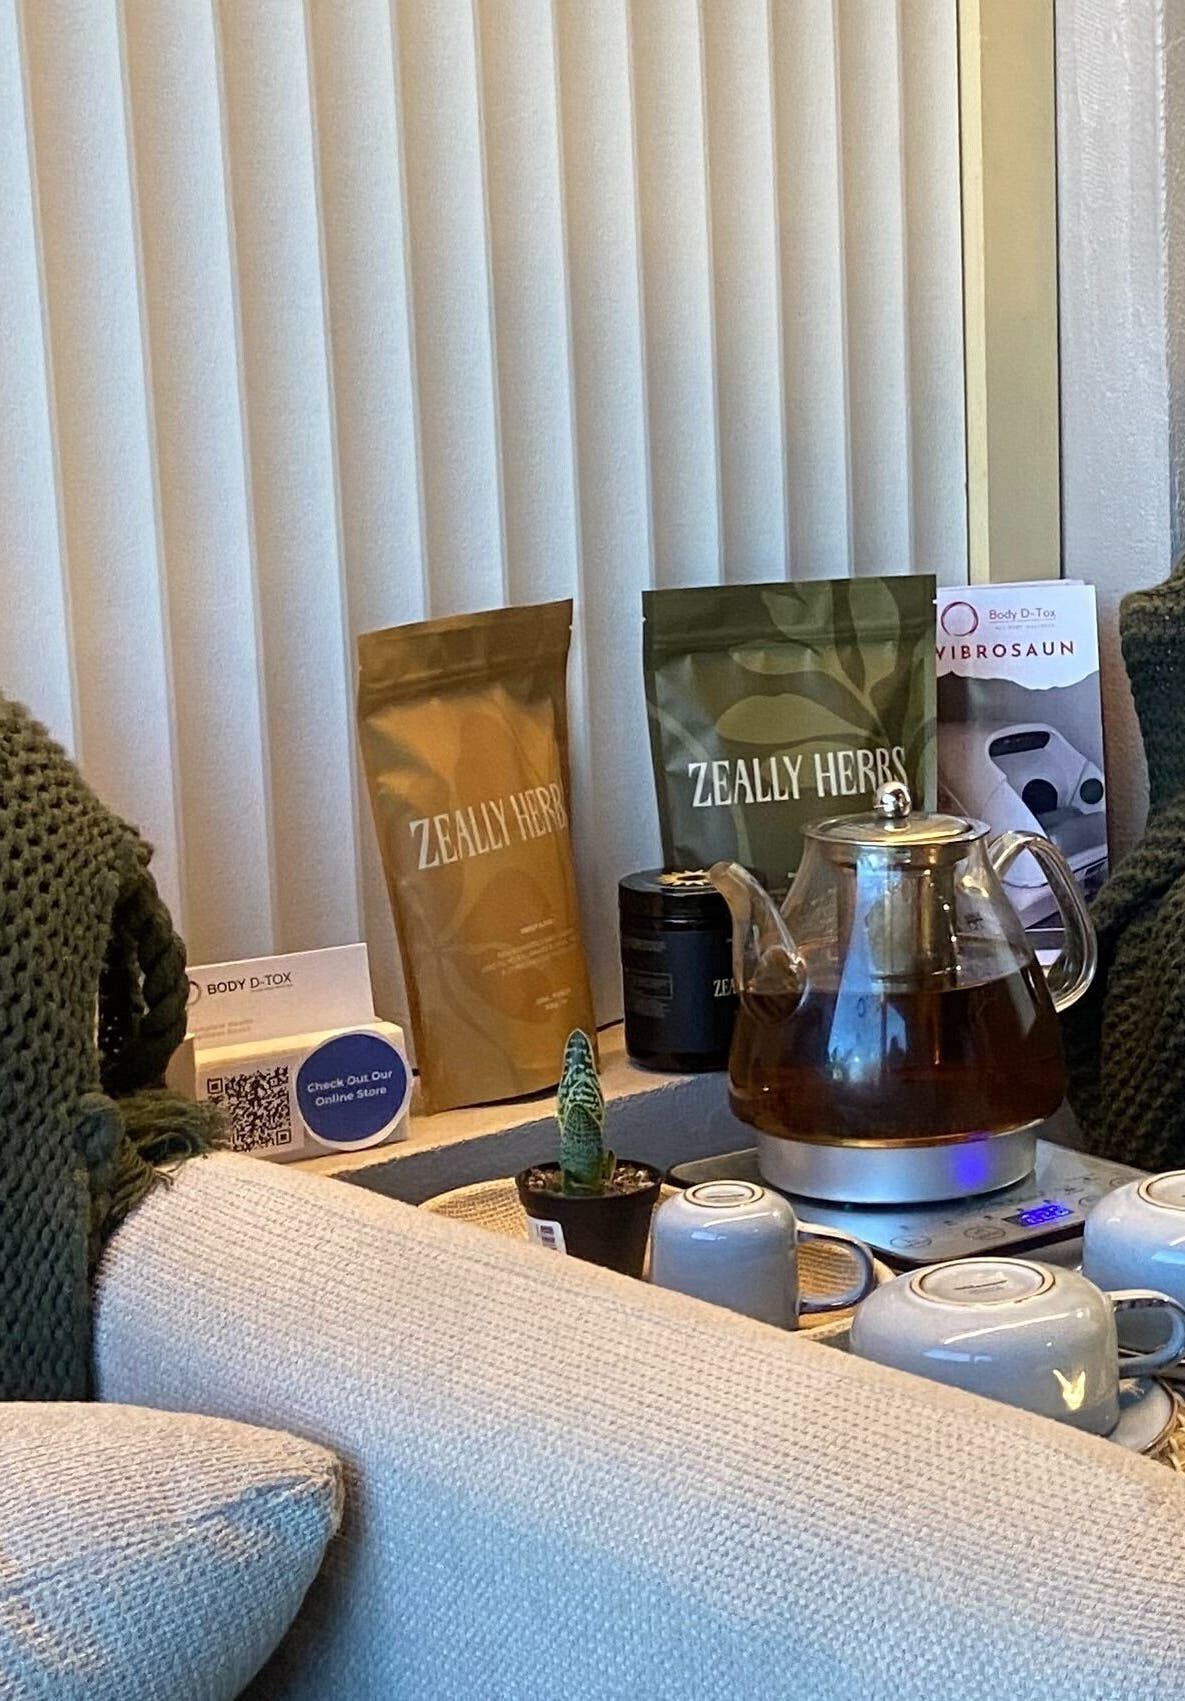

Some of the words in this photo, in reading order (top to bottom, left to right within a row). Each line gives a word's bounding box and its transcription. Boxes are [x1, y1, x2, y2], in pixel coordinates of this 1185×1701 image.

[988, 609, 1017, 621] Body
[1020, 607, 1056, 618] D-Tox
[935, 640, 1074, 660] VIBROSAUN
[688, 754, 802, 808] ZEALLY
[814, 746, 908, 798] HERBS
[408, 798, 511, 870] ZEALLY
[509, 783, 567, 841] HERB
[207, 978, 246, 995] BODY
[250, 971, 292, 989] D-TOX
[713, 978, 737, 997] ZEA
[307, 1078, 345, 1093] Check
[347, 1074, 369, 1085] Out
[371, 1070, 393, 1081] Our
[315, 1092, 354, 1106] Online
[356, 1086, 387, 1099] Store
